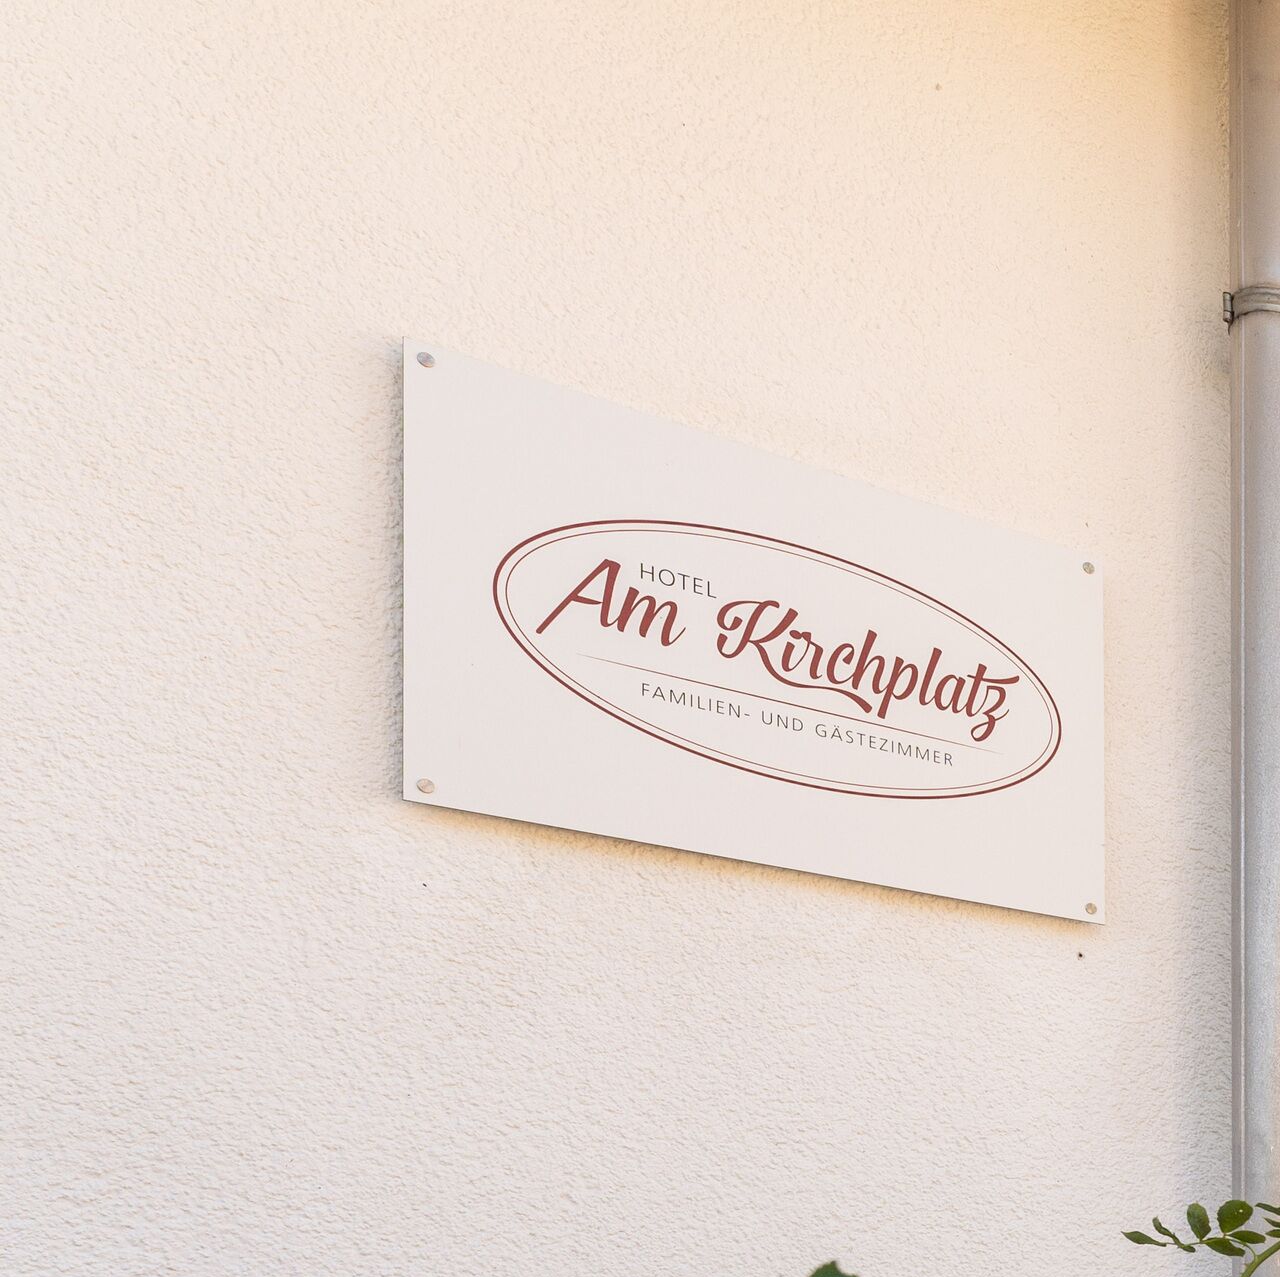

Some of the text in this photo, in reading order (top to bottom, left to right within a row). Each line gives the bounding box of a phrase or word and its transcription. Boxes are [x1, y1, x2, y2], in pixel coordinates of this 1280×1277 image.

[639, 562, 717, 599] HOTEL
[535, 558, 1020, 742] Am Kirchplatz
[640, 682, 954, 767] FAMILIEN- UND GÄSTEZIMMER
